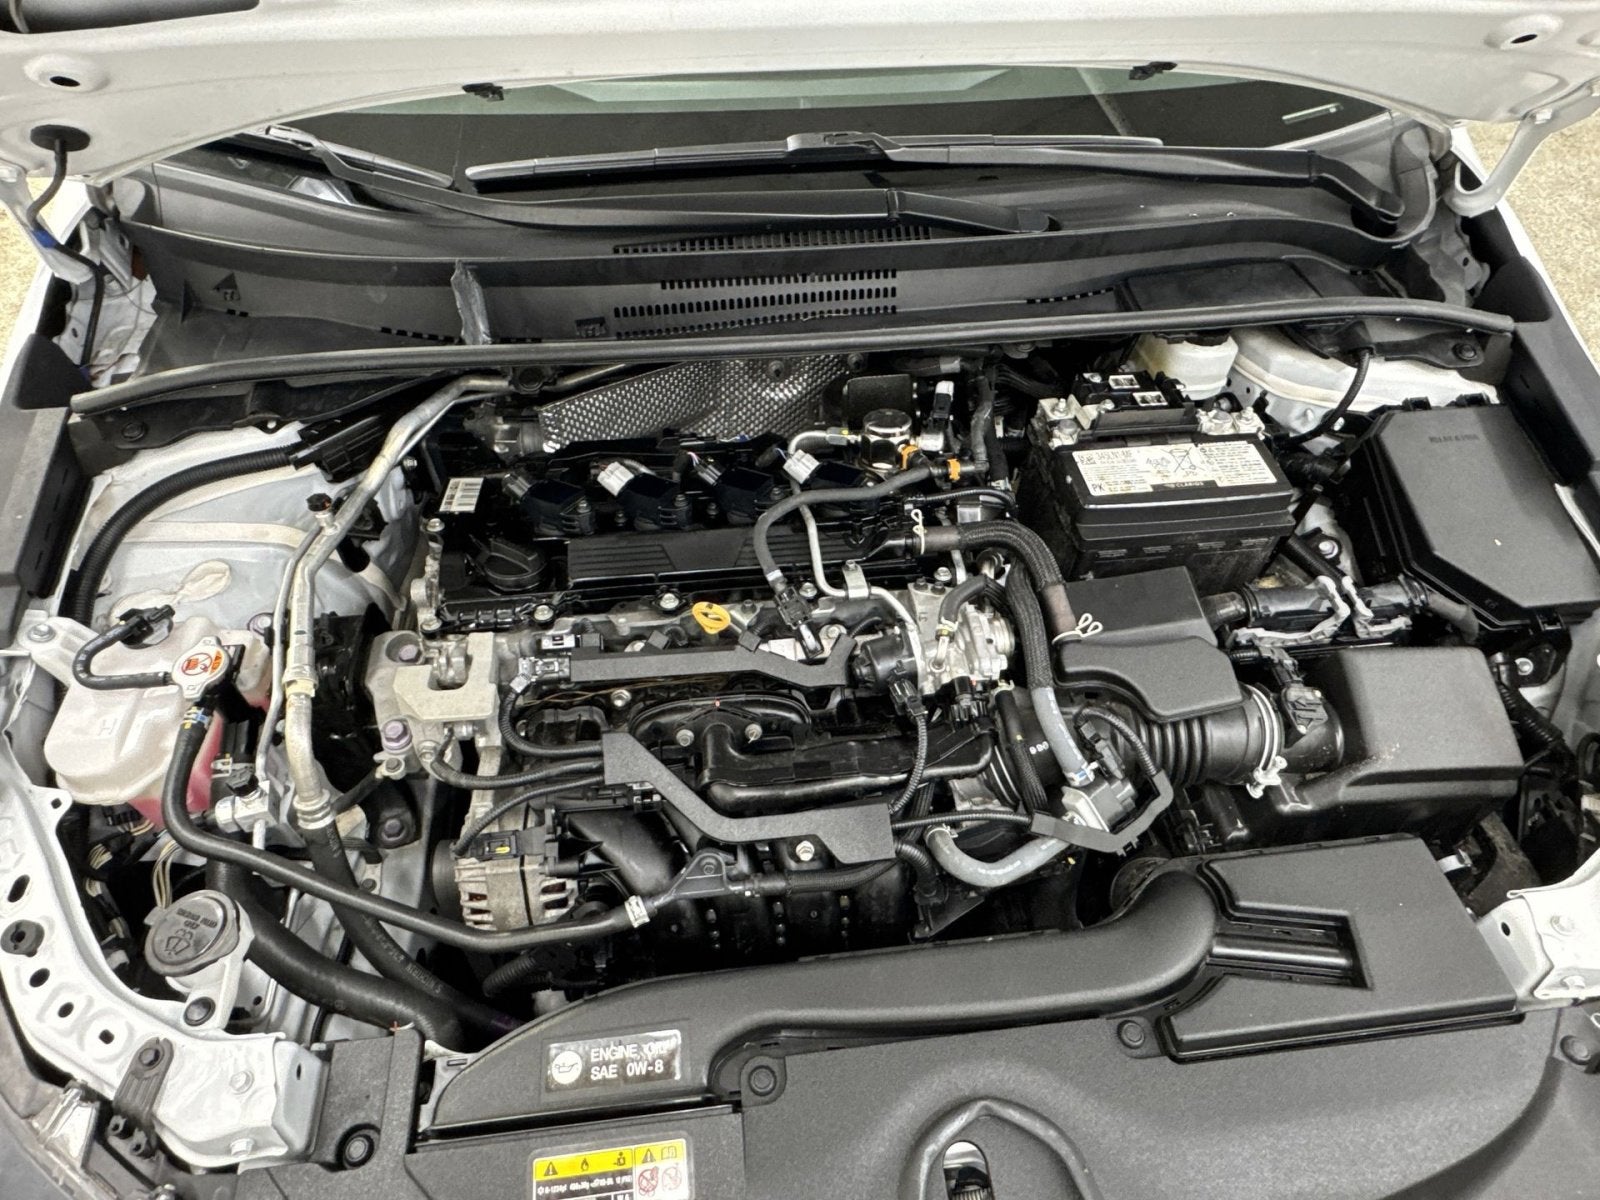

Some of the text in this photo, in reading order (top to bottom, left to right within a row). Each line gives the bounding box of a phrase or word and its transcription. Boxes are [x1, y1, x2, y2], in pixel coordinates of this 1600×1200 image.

[591, 1043, 638, 1062] ENGINE
[591, 1059, 664, 1080] SAE 0W-8
